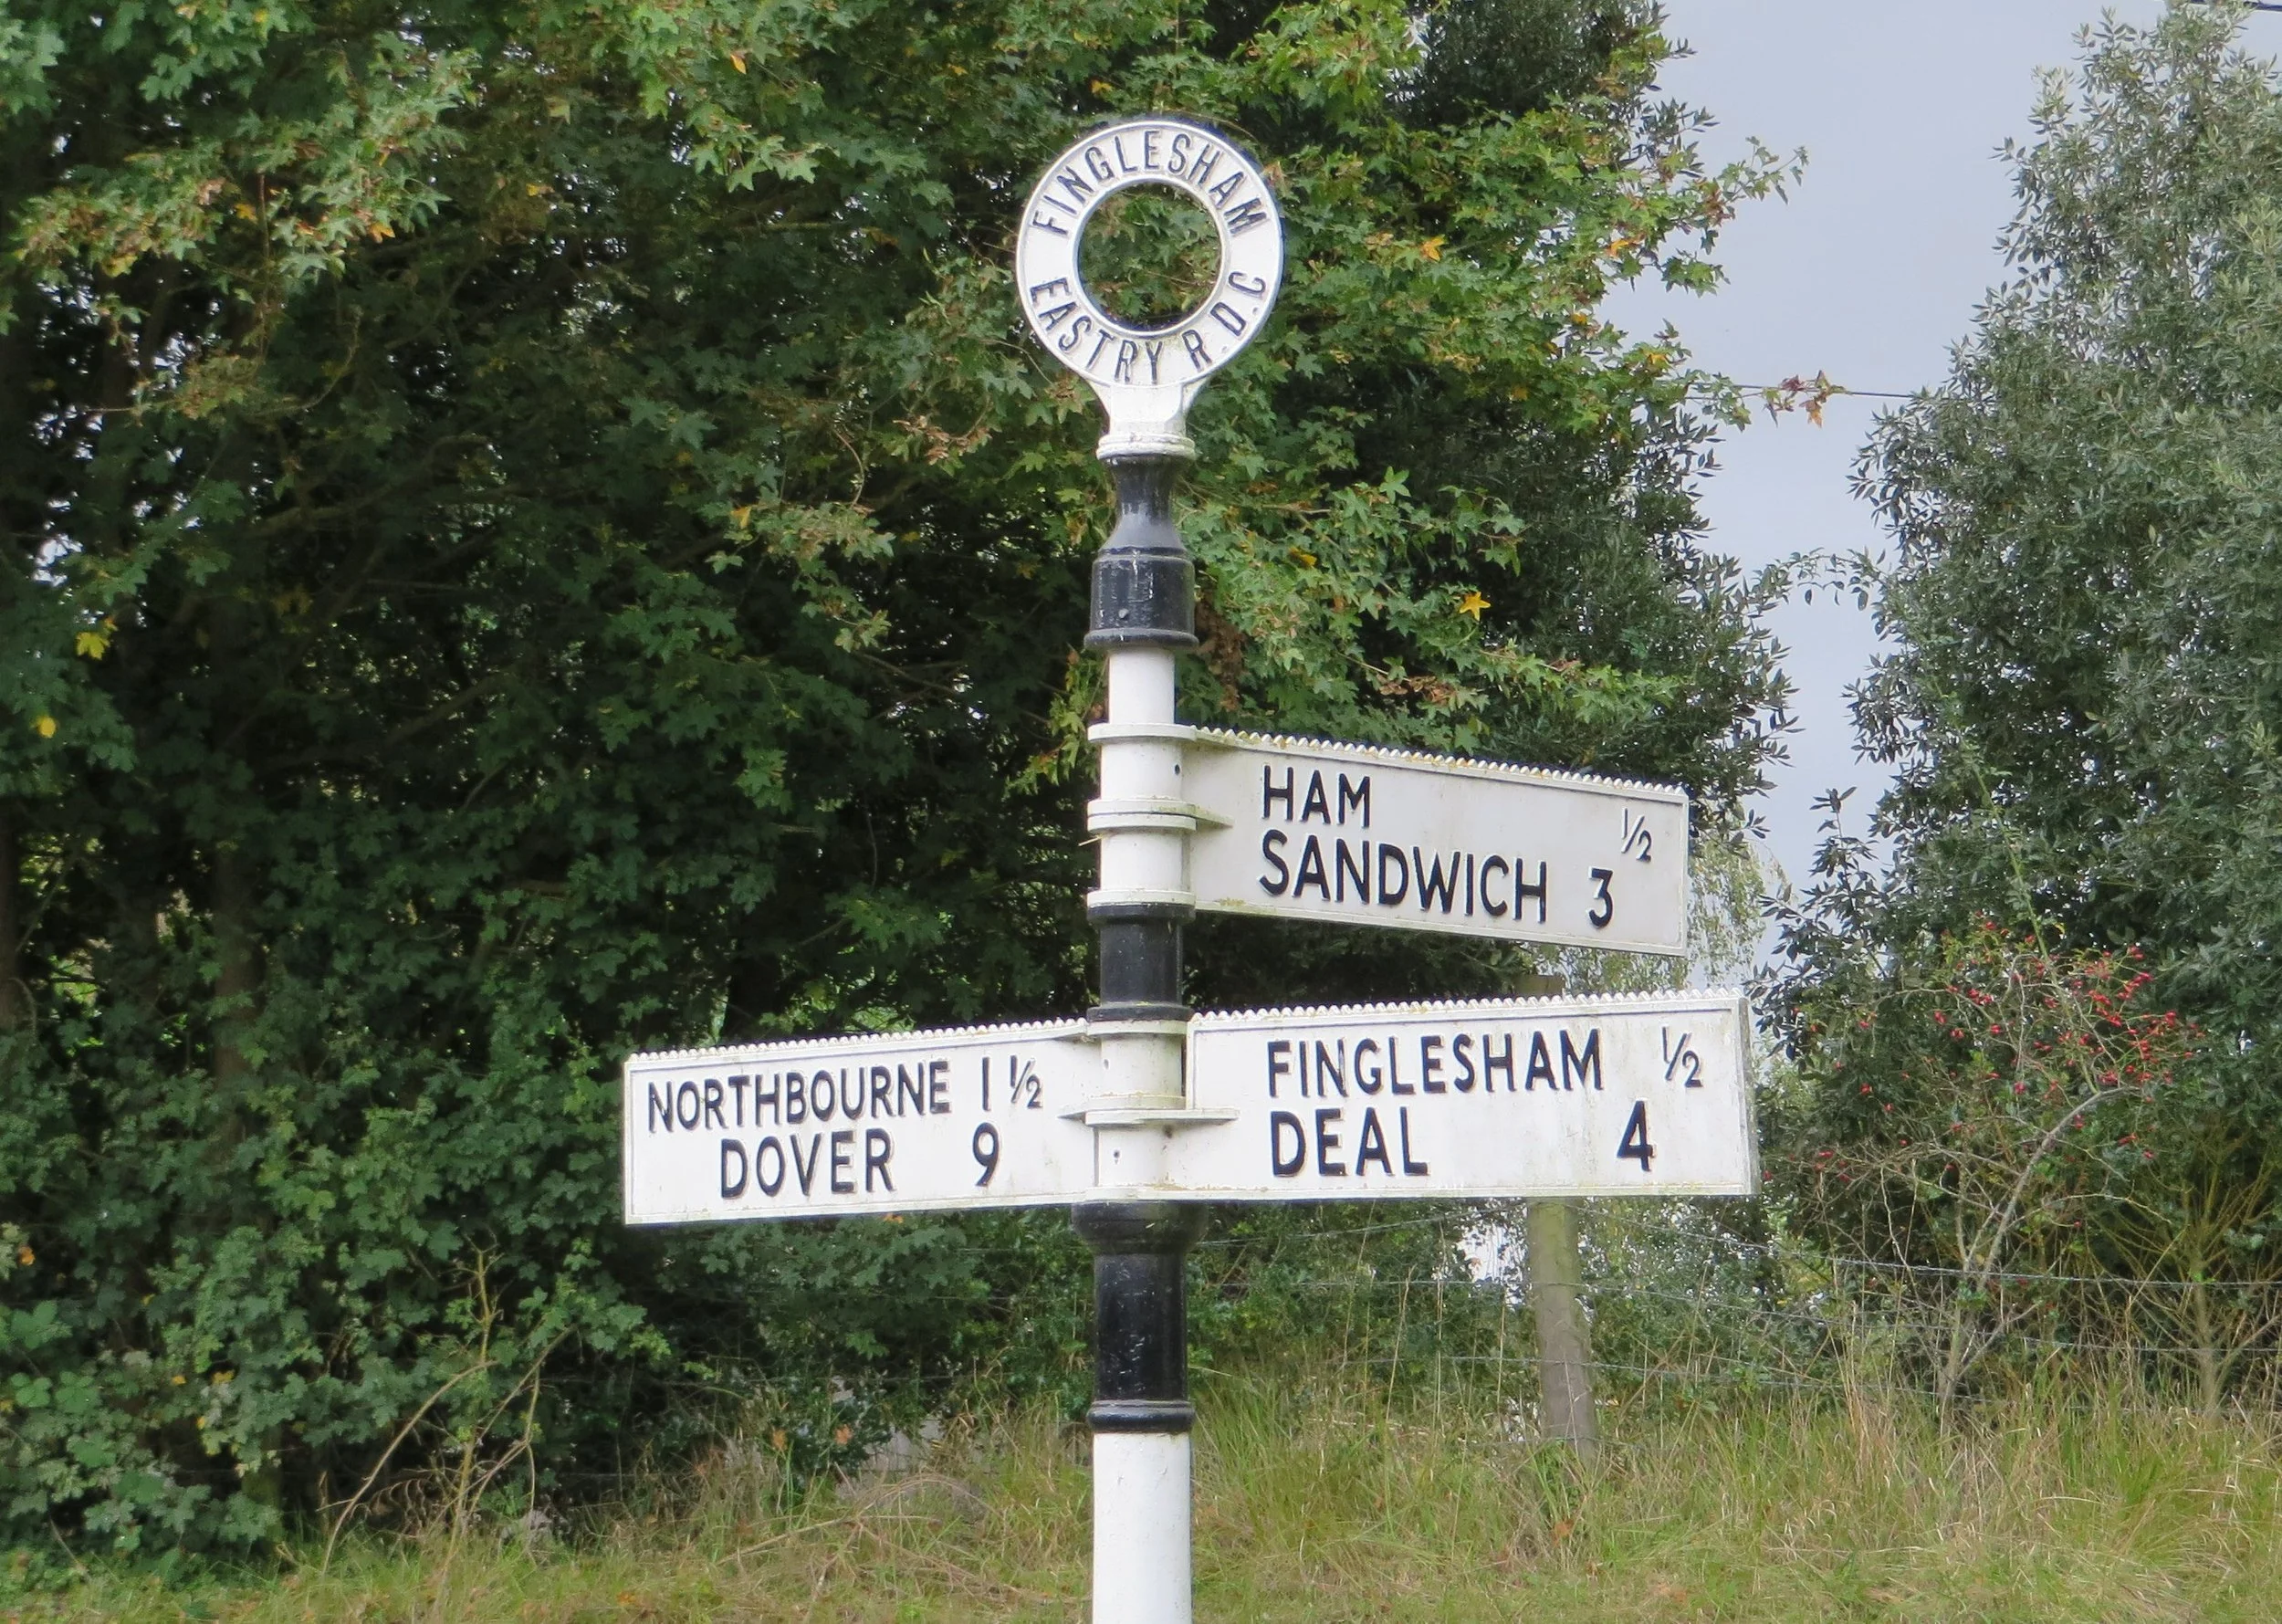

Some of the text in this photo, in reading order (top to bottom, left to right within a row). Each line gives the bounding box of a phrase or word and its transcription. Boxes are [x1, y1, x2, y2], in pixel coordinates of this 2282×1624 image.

[1031, 130, 1268, 236] FINGLESHAM
[1030, 277, 1162, 384] EASTRY
[1262, 765, 1371, 829] HAM
[1258, 829, 1614, 928] SANDWICH 3
[647, 1059, 951, 1133] NORTHBOURNE
[1267, 1028, 1604, 1097] FINGLESHAM
[720, 1121, 1000, 1200] DOVER 9
[1270, 1100, 1654, 1177] DEAL 4
